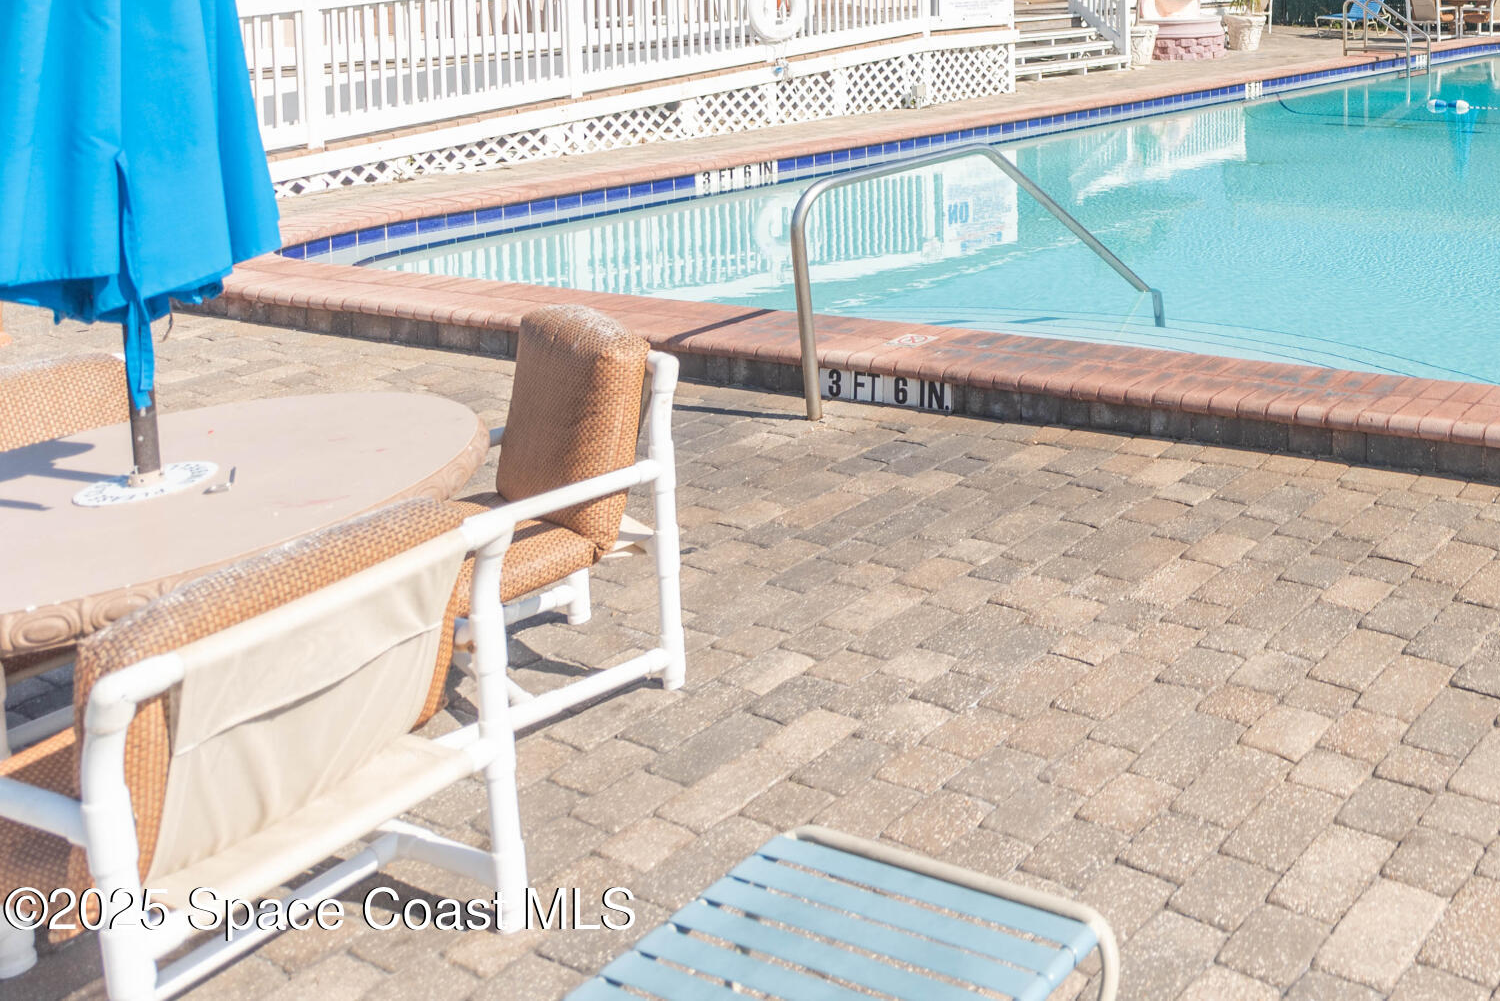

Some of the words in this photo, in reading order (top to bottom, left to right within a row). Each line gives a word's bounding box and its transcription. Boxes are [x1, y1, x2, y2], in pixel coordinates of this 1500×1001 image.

[702, 171, 711, 185] 3
[719, 167, 736, 182] FT
[743, 164, 752, 178] 6
[759, 160, 774, 176] IN
[828, 368, 842, 397] 3
[854, 371, 881, 403] FT
[894, 377, 908, 405] 6
[919, 379, 950, 411] IN.
